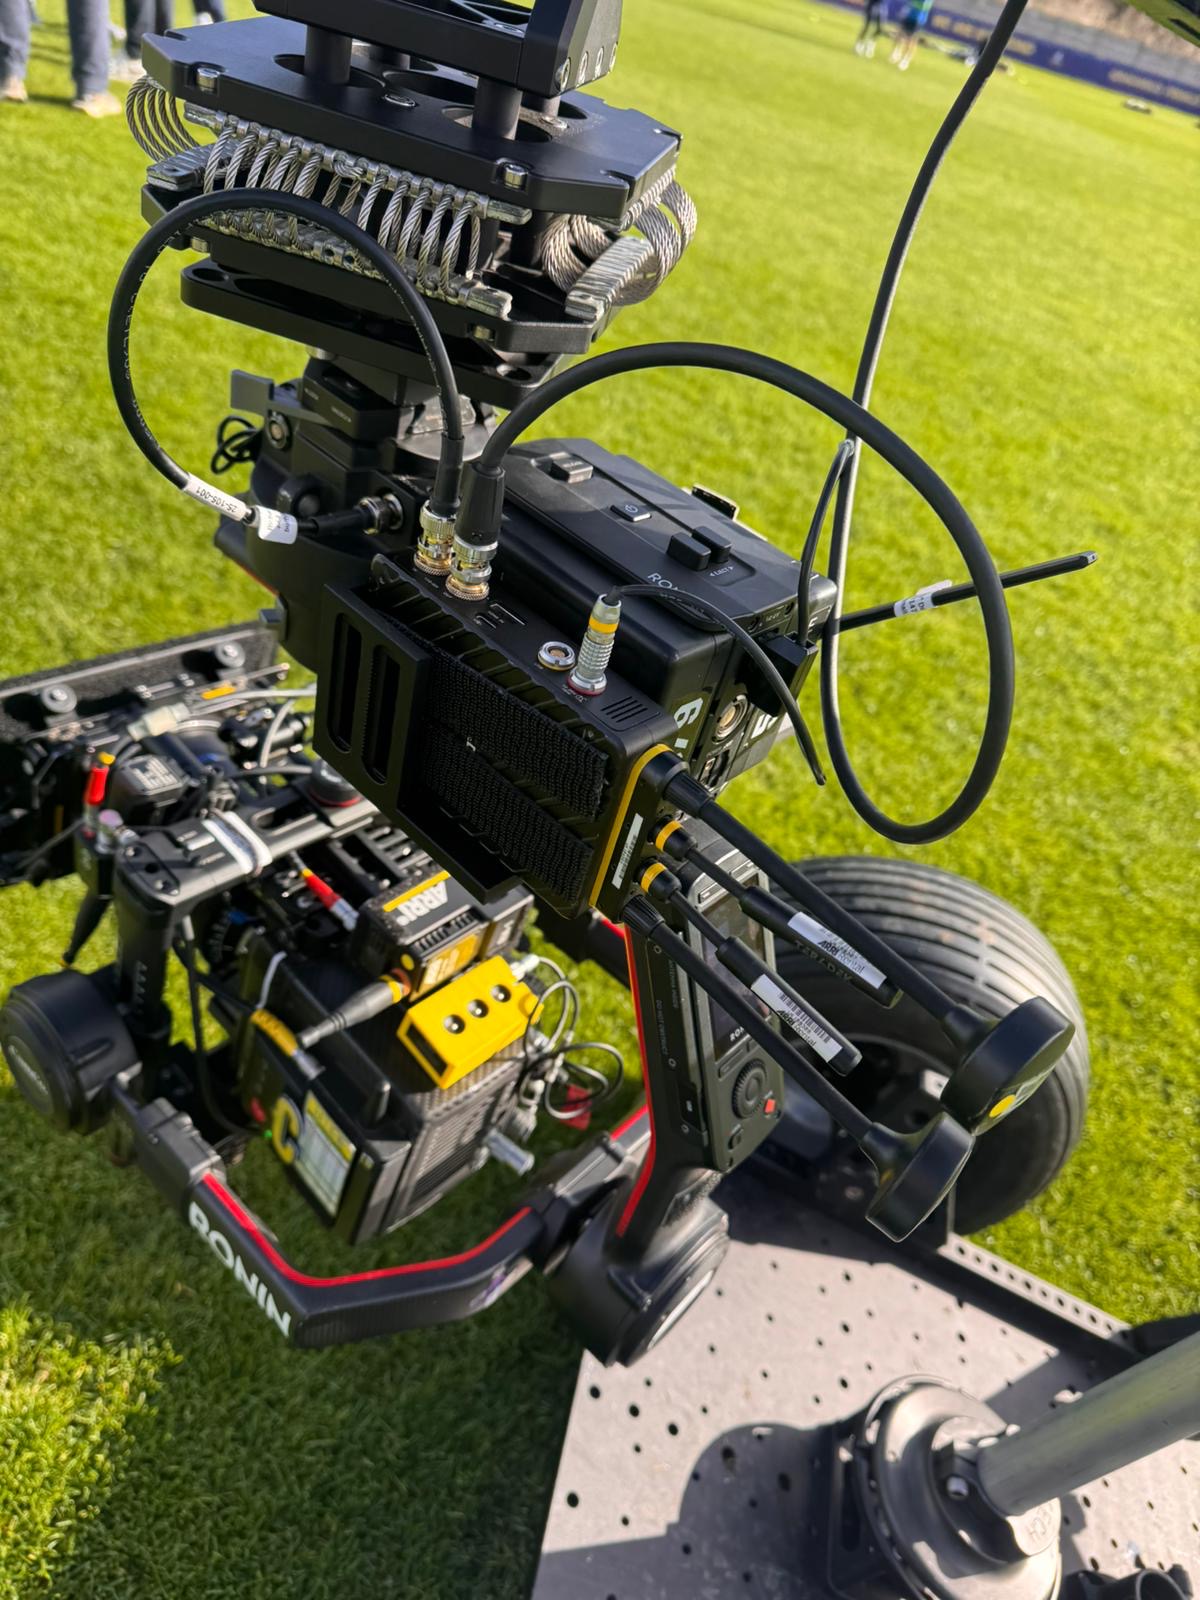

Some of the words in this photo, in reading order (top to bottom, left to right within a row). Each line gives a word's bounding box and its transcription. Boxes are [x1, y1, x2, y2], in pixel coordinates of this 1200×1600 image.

[196, 486, 238, 513] 25-105-001
[817, 940, 840, 957] ARRI
[776, 1009, 795, 1026] ARRI
[189, 1201, 292, 1337] RONIN
